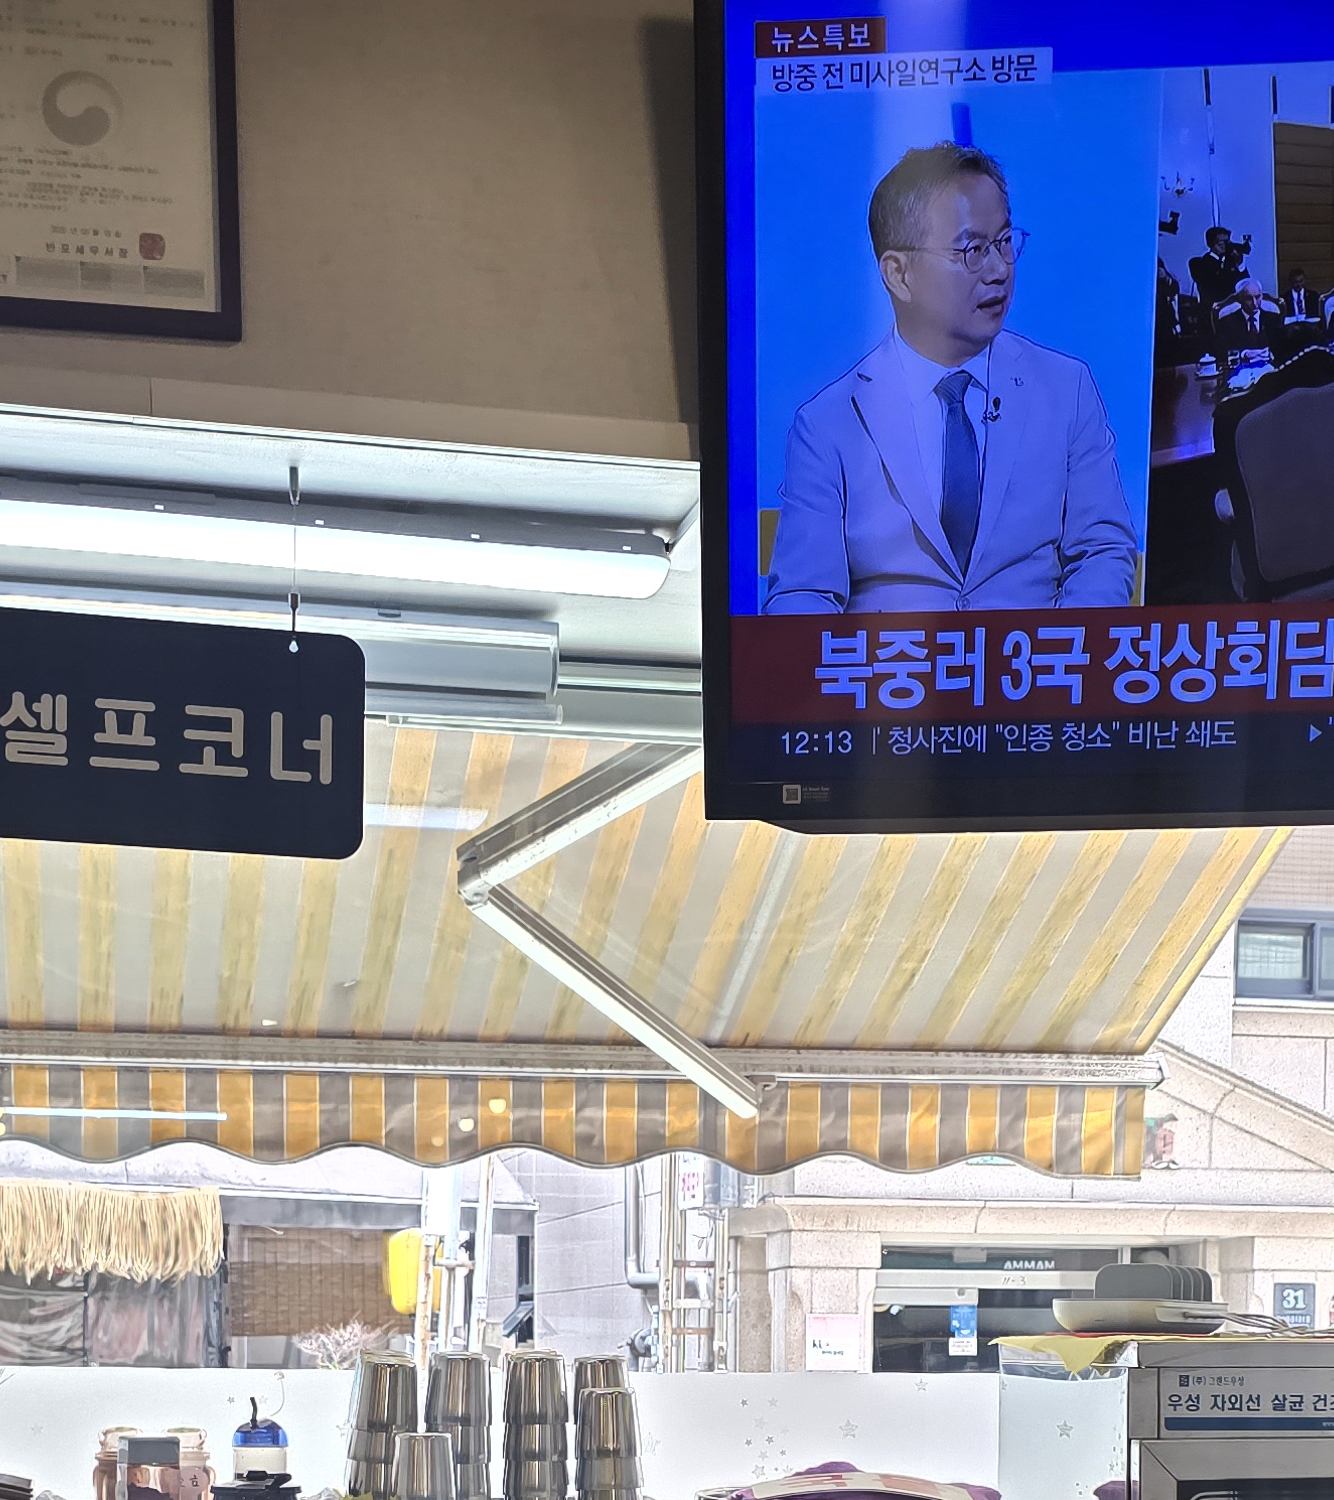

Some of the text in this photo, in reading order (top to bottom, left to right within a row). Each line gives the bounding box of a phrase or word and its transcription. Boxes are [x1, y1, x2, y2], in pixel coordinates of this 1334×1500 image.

[771, 23, 871, 52] 뉴스특보
[771, 54, 1037, 93] 방중 전 미사일연구소 방문
[814, 627, 986, 709] 북중러
[1001, 625, 1089, 705] 3국
[0, 691, 333, 785] 셀프코너
[781, 730, 852, 754] 12:13
[888, 724, 987, 754] 청사진에
[995, 723, 1052, 752] "인종
[1062, 722, 1119, 751] 청소"
[1129, 722, 1177, 750] 비난
[1185, 719, 1236, 748] 쇄도
[1282, 1289, 1307, 1309] 31
[1167, 1394, 1201, 1411] 우성
[1210, 1394, 1261, 1411] 자외선
[1271, 1394, 1304, 1411] 살균
